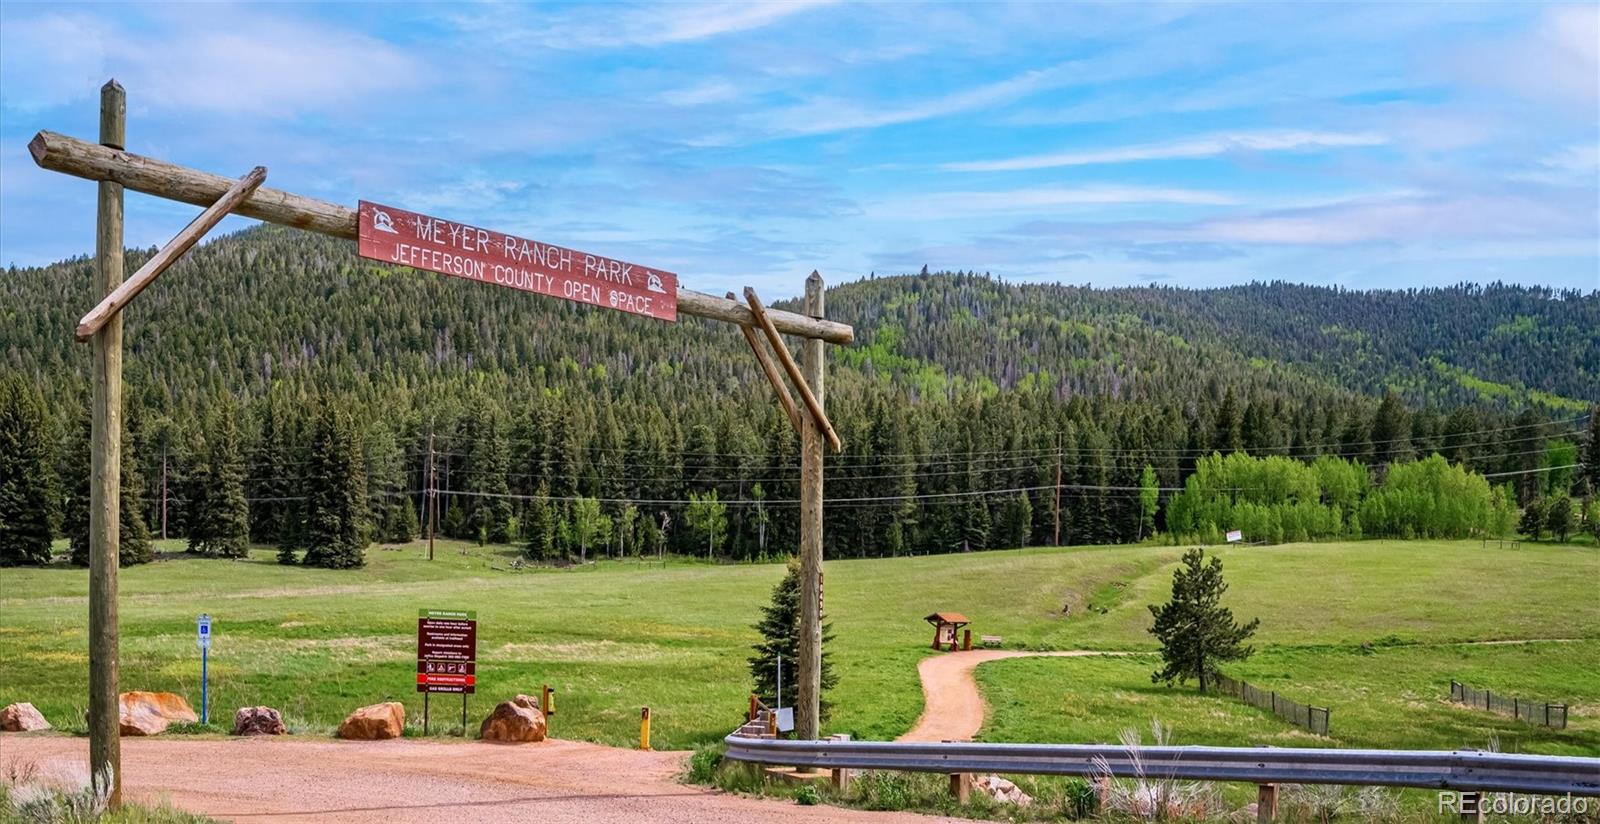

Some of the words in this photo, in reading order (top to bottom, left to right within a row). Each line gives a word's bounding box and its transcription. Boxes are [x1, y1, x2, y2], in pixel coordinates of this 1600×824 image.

[391, 243, 484, 279] JEFFERSON
[494, 264, 554, 291] COUNTY
[563, 279, 600, 303] OPEN
[609, 289, 653, 315] SPACE
[416, 215, 489, 254] MEYER
[504, 236, 572, 272] RANCH
[584, 254, 633, 286] PARK
